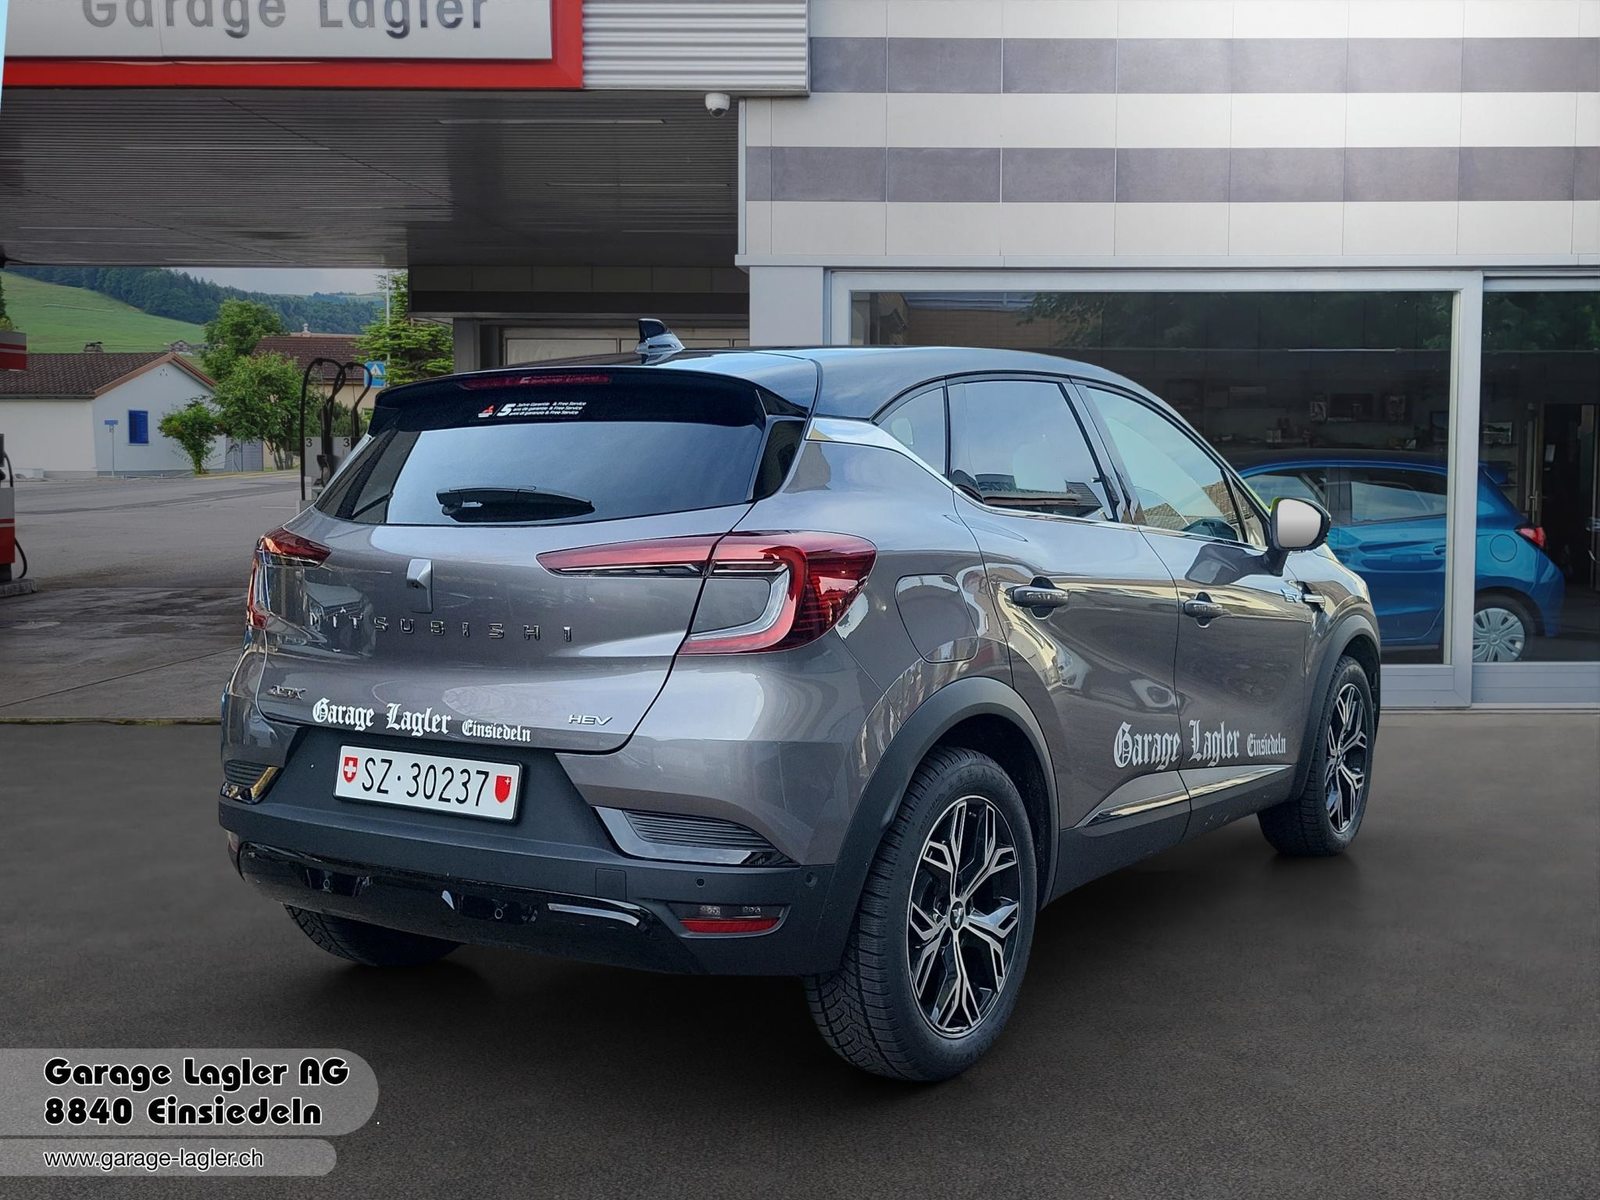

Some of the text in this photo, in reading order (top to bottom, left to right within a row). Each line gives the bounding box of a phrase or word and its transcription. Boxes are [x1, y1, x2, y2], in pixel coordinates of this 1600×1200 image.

[82, 0, 488, 39] Garage Lagler
[497, 403, 516, 416] 5
[306, 438, 312, 447] 3
[344, 438, 350, 447] 3
[310, 611, 573, 642] MITSUBISHI
[312, 698, 532, 743] Garage Lagler Einsiedeln
[568, 713, 614, 726] HEV
[1113, 719, 1287, 771] Garage Lagler Einsiedeln
